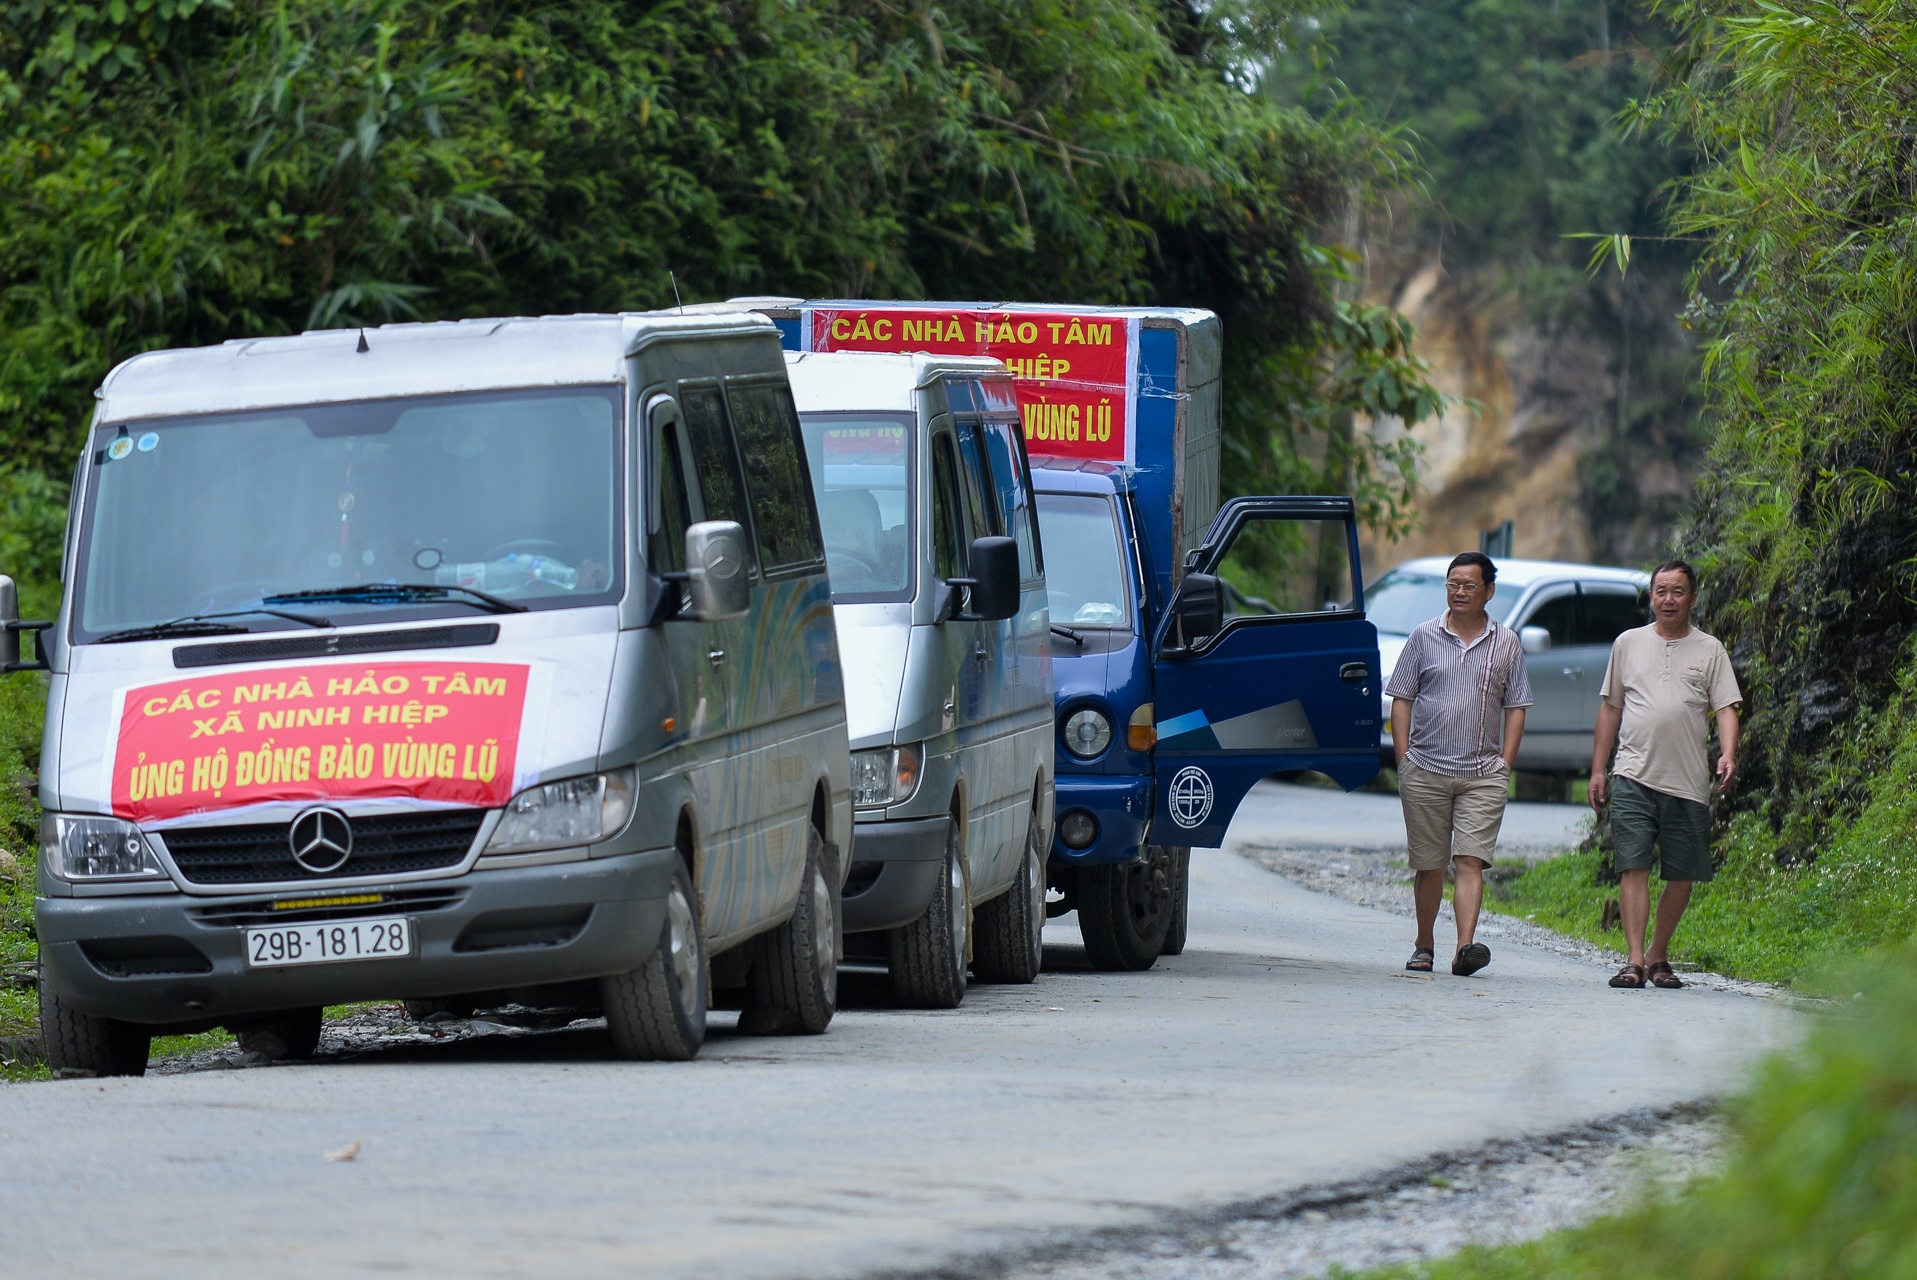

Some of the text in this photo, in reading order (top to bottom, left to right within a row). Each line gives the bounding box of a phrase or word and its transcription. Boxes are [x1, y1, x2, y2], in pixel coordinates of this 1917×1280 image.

[831, 313, 1112, 346] CÁC NHÀ HẢO TÂM
[1005, 352, 1071, 387] HIỆP
[1024, 395, 1112, 442] VÙNG LŨ
[143, 670, 507, 717] CÁC NHÀ HẢO TÂM
[190, 700, 449, 739] XÃ NINH HIỆP
[130, 736, 499, 801] ỦNG HỘ ĐỒNG BÀO VÙNG LŨ
[252, 923, 404, 962] 29B-181.28
